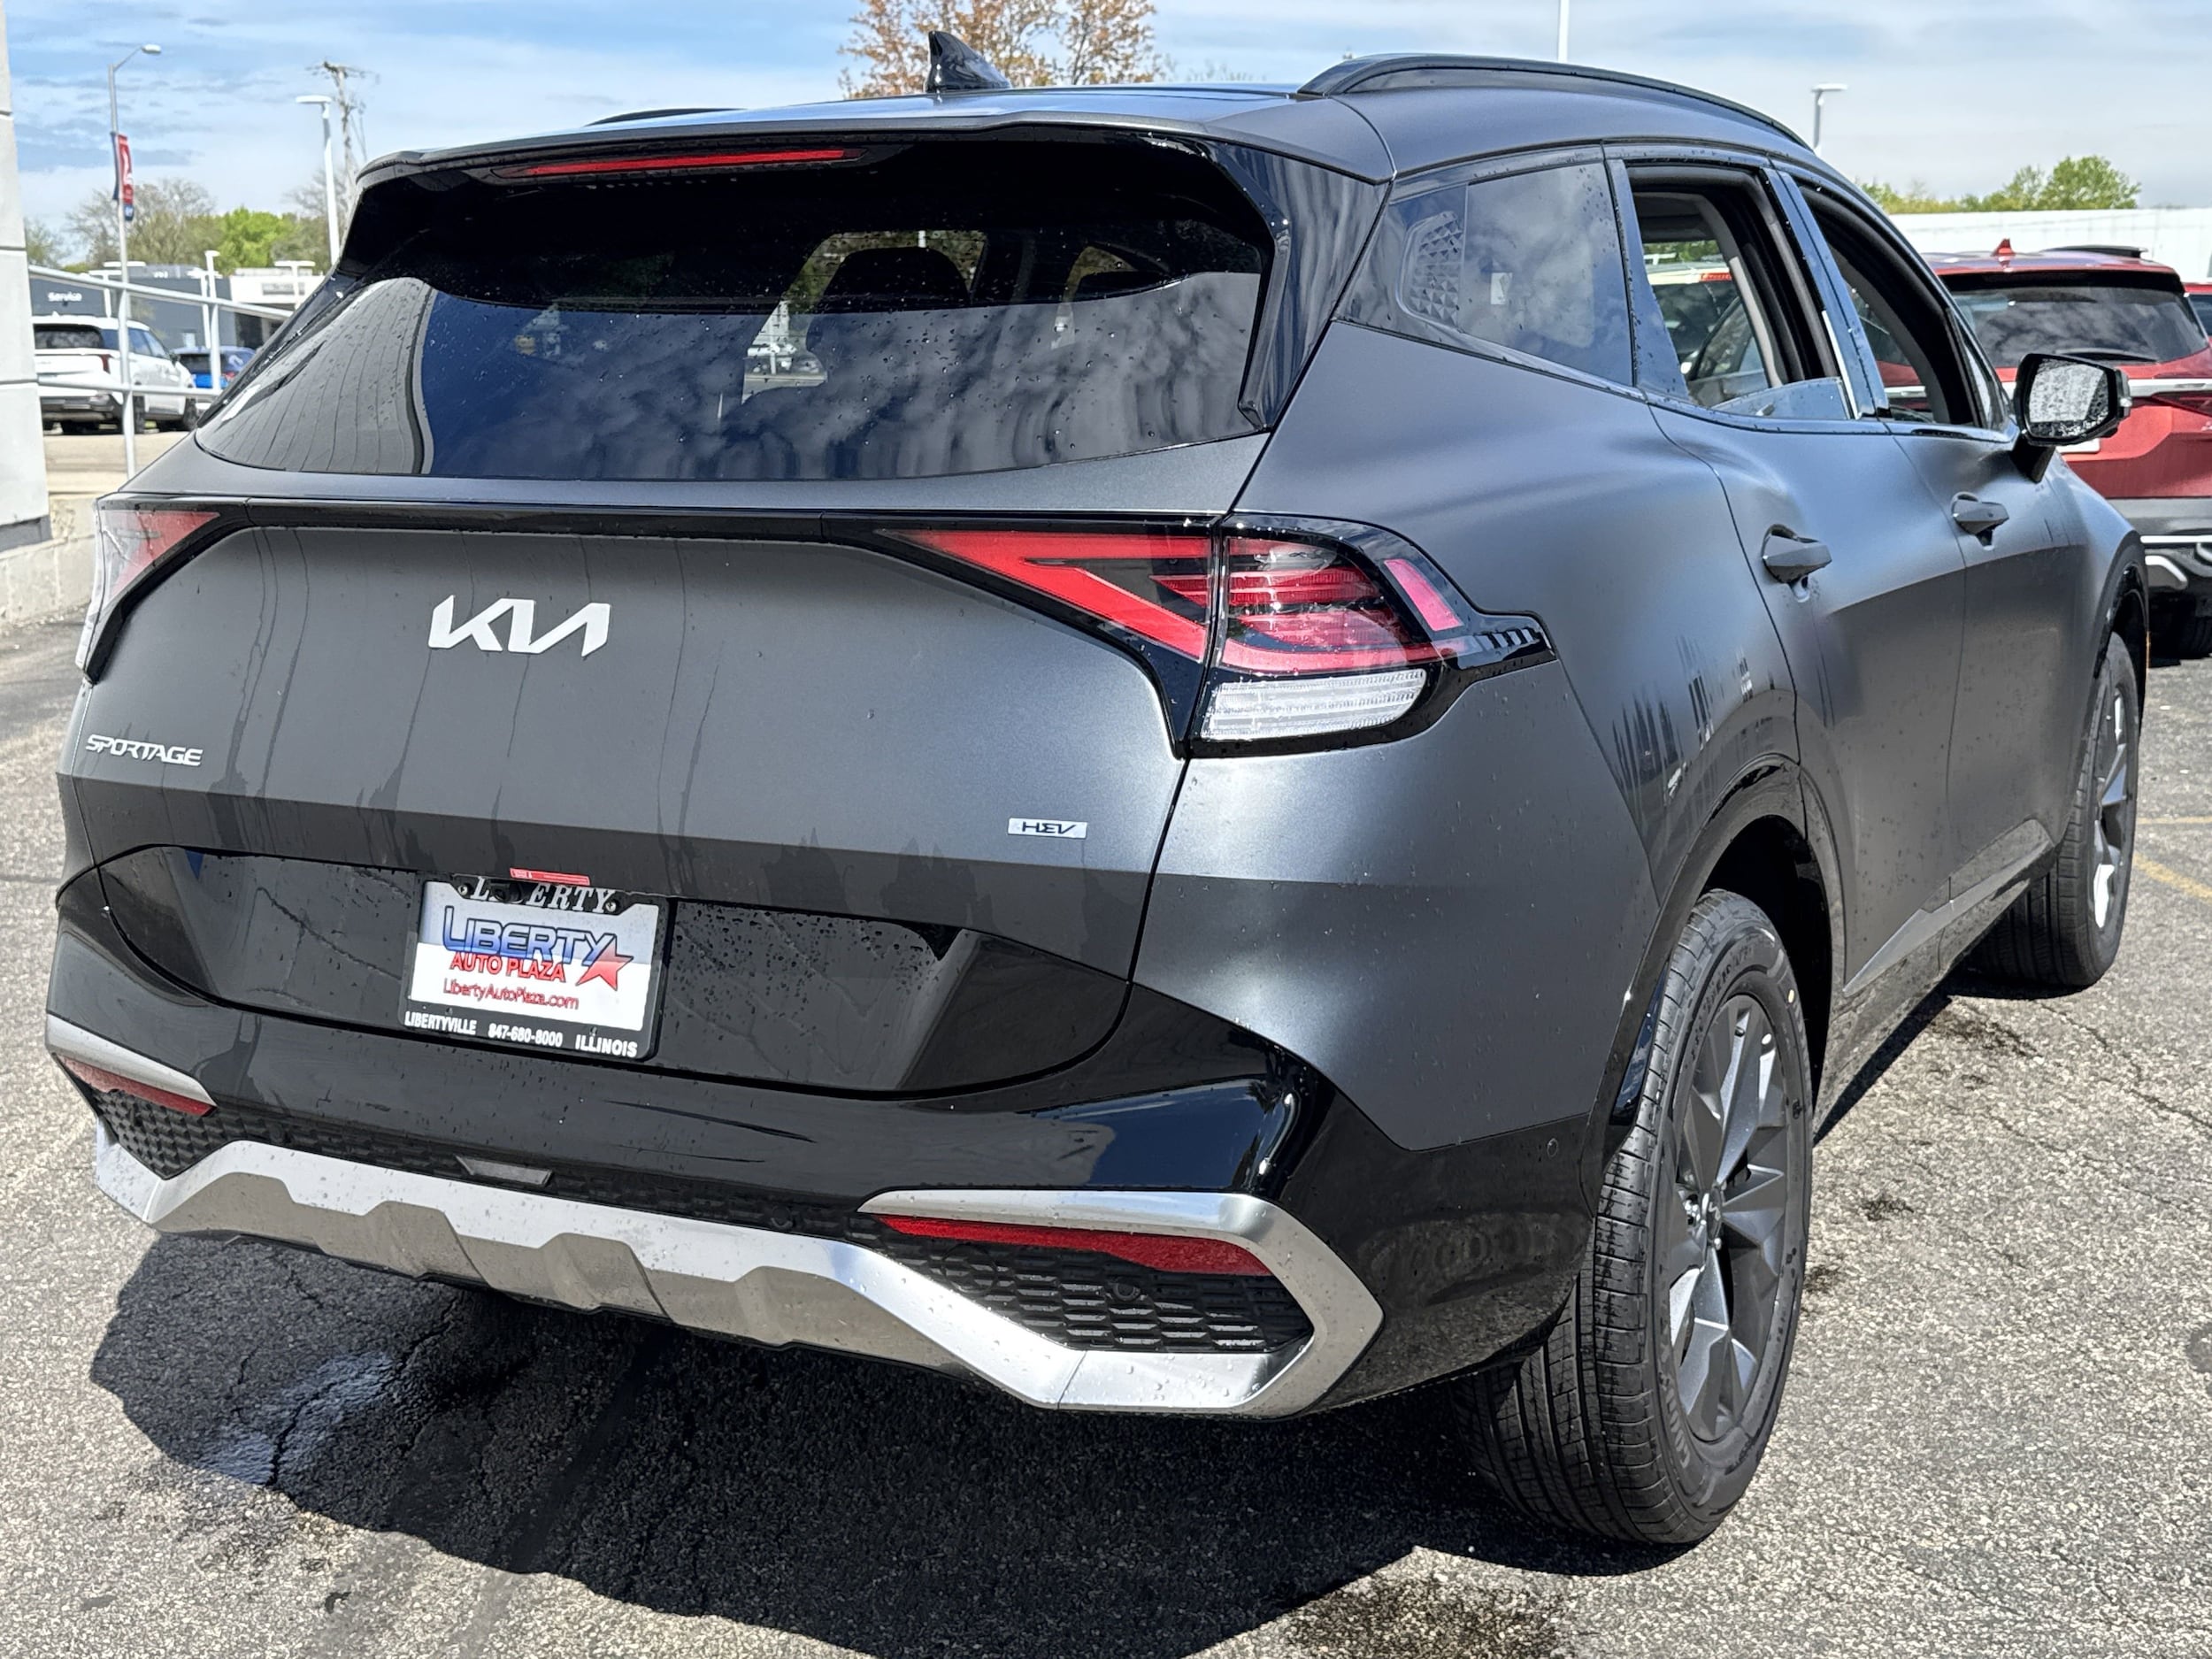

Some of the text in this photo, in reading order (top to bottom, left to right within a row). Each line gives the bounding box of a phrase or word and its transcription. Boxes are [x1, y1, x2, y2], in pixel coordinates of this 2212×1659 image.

[428, 594, 611, 657] KIA
[86, 733, 204, 766] SPORTAGE
[1022, 821, 1077, 834] HEV
[470, 876, 615, 914] LERTY
[442, 905, 617, 967] LIBERTY
[449, 951, 566, 982] AUTO PLAZA
[443, 978, 580, 1010] LibertyAutoPlaza.com
[404, 1010, 638, 1058] LIBERTYVILLE 847-680-8000 ILLINOIS
